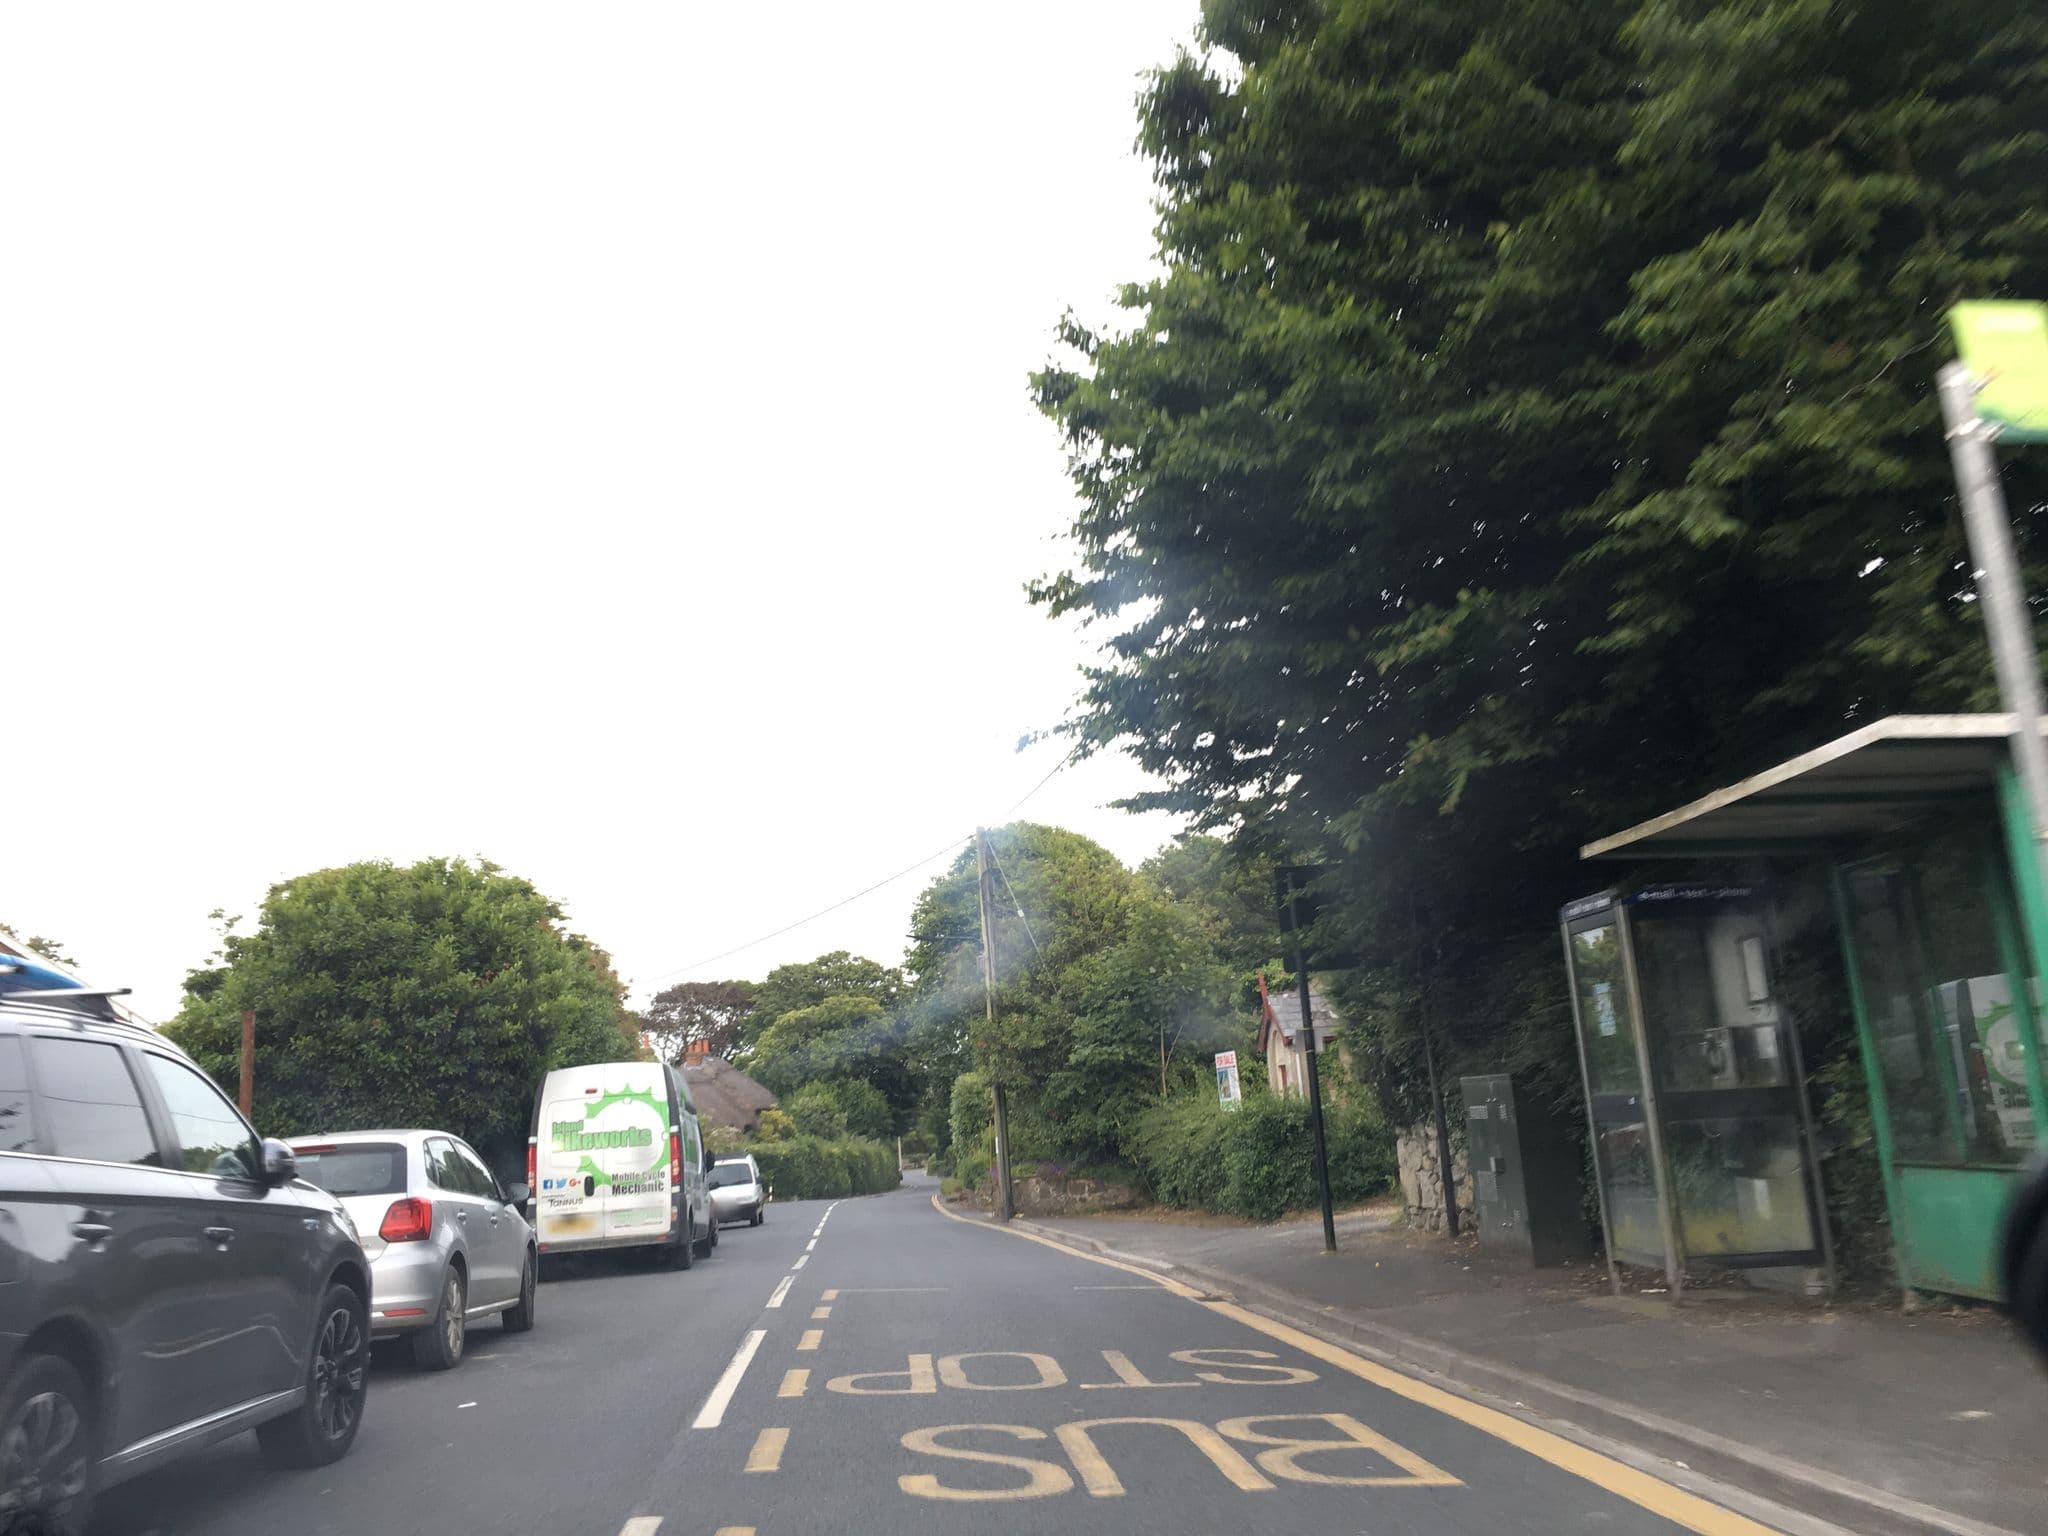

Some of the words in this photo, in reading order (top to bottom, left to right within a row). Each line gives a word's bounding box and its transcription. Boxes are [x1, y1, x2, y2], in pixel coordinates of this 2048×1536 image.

[612, 1172, 640, 1183] Mobile
[612, 1181, 664, 1196] Mechanic
[825, 1348, 1320, 1397] STOP
[898, 1412, 1463, 1502] BUS
